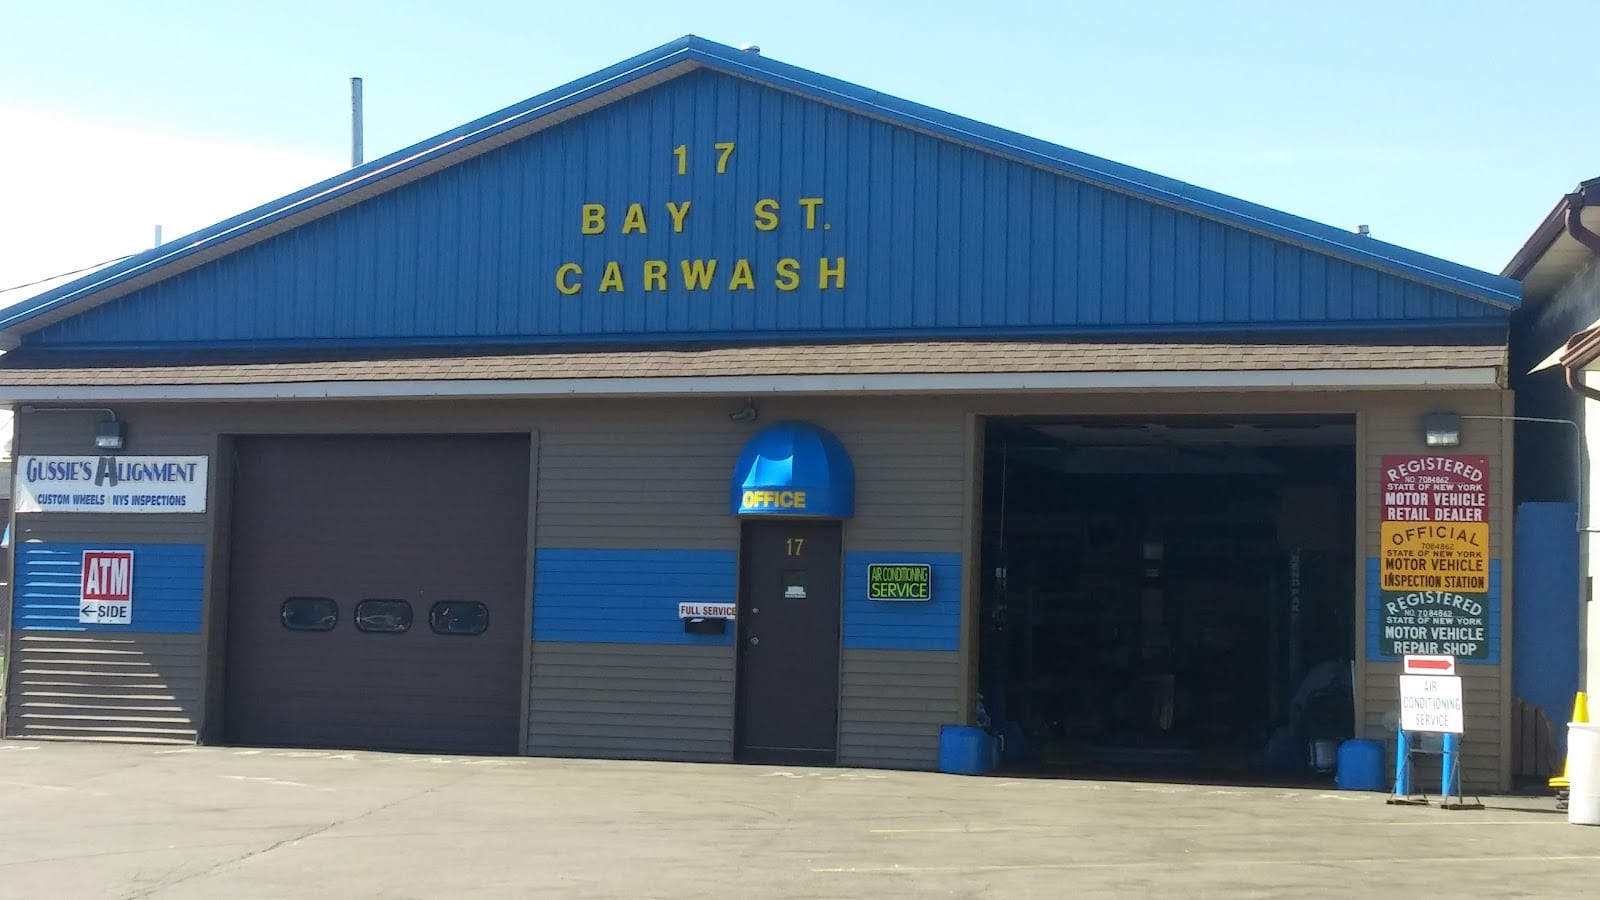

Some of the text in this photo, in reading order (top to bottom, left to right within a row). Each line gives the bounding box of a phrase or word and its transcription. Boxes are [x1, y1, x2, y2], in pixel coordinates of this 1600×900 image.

[581, 197, 831, 235] BAY ST.
[555, 256, 846, 295] CARWASH
[26, 456, 198, 487] GUSSIE'S ALIGNMENT
[1387, 457, 1483, 482] REGISTERED
[1387, 483, 1483, 492] STATE OF NEW YORK
[37, 494, 187, 506] CUSTOM WHEELS NYS INSPECTIONS
[743, 490, 807, 509] OFFICE
[1385, 492, 1486, 507] MOTOR VEHICLE
[1388, 507, 1483, 522] RETAIL DEALER
[1392, 525, 1480, 547] OFFICIAL
[786, 537, 804, 556] 17
[1387, 549, 1415, 557] STATE
[1433, 550, 1454, 558] NEW
[1457, 551, 1483, 559] YORK
[1386, 558, 1484, 573] MOTOR VEHICLE
[86, 557, 128, 596] ATM
[872, 567, 928, 582] AIR CONDITIONING
[1384, 573, 1485, 589] INSPECTION STATION
[871, 582, 928, 598] SERVICE
[681, 605, 737, 616] FULL SERVICE
[1386, 591, 1483, 616] REGISTERED
[97, 605, 127, 619] SIDE
[1386, 616, 1415, 624] STATE
[1432, 617, 1455, 625] NEW
[1457, 618, 1483, 626] YORK
[1385, 626, 1485, 641] MOTOR VEHICLE
[1394, 641, 1478, 656] REPAIR SHOP
[1423, 680, 1438, 693] AIR
[1403, 696, 1461, 711] CONDITIONING
[1415, 713, 1449, 727] SERVICE
